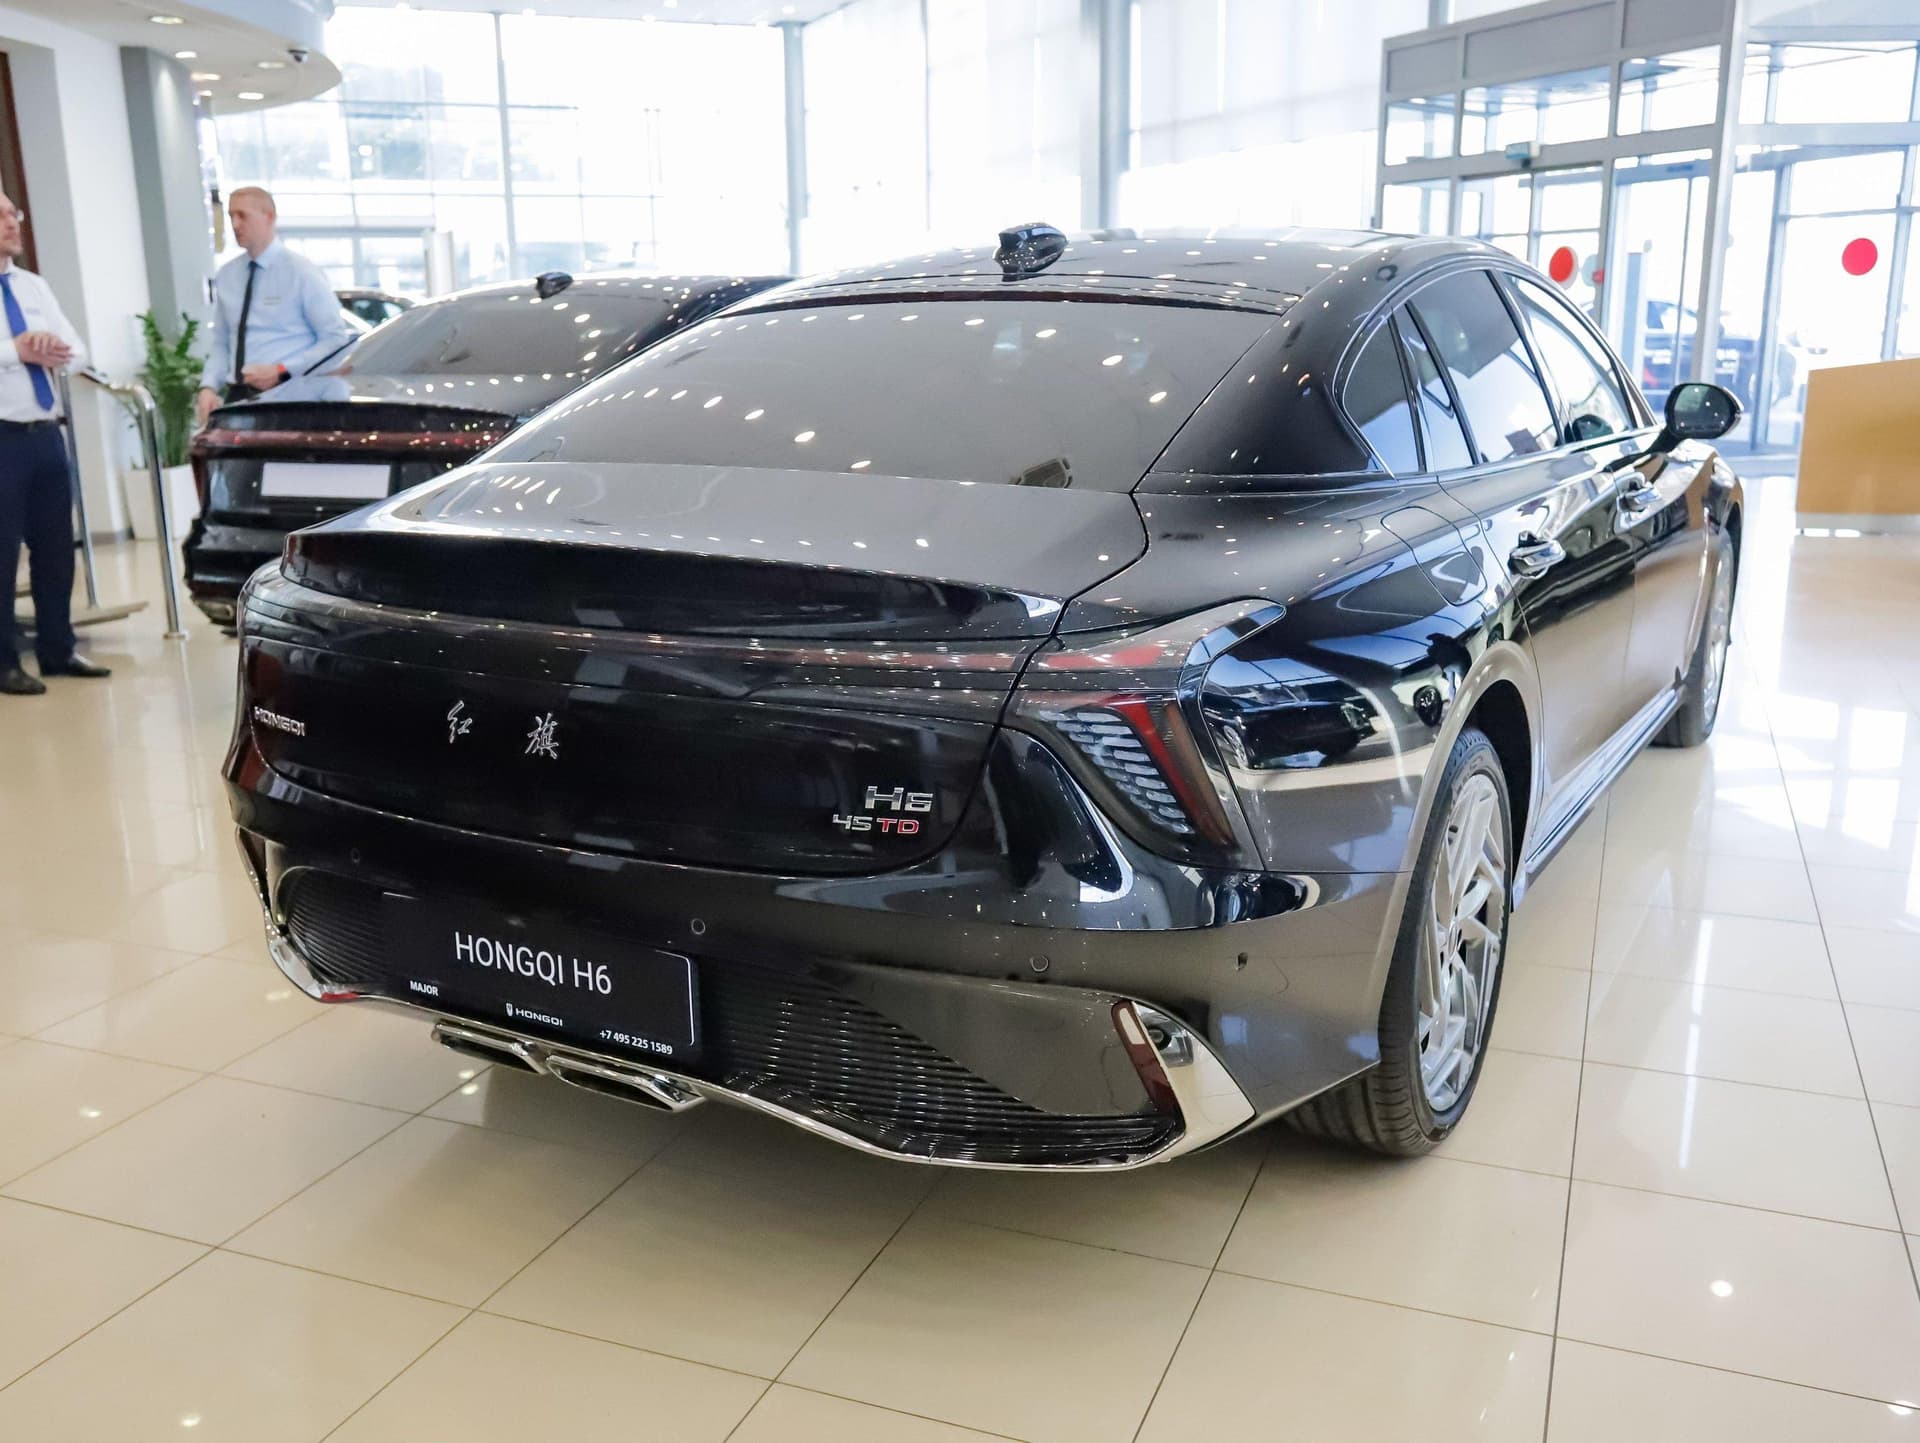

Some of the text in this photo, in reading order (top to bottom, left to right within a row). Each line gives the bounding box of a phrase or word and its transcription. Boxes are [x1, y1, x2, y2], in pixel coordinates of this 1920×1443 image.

[253, 705, 306, 737] HONGQI
[864, 785, 934, 812] H6
[454, 931, 613, 995] HONGQI H6
[410, 980, 439, 997] MAJOR
[515, 1007, 563, 1027] HONGQI
[599, 1029, 672, 1055] +7 495 225 1589
